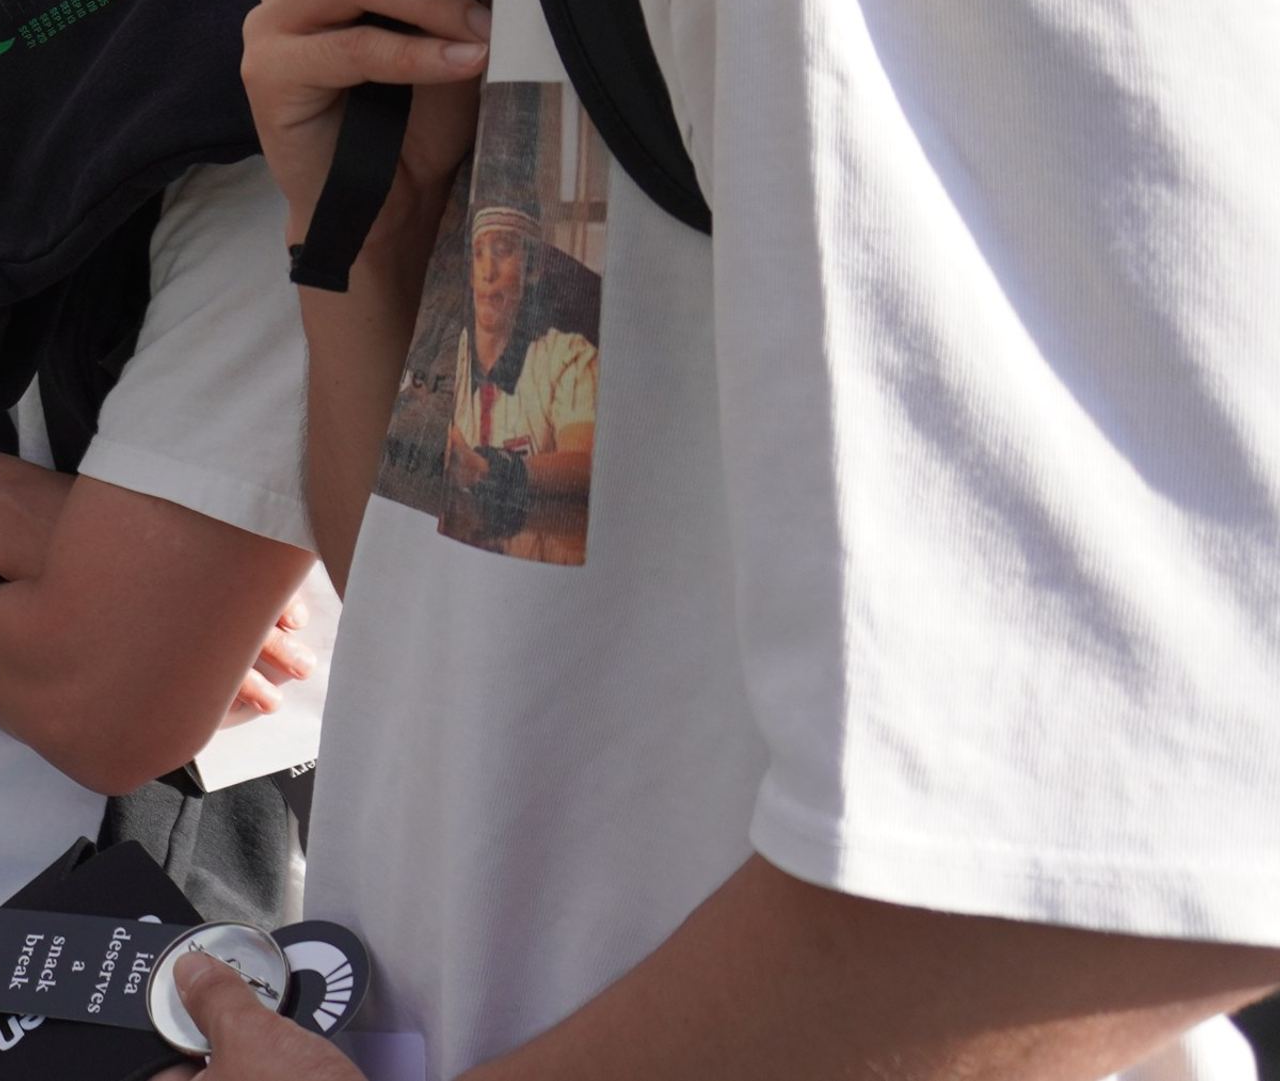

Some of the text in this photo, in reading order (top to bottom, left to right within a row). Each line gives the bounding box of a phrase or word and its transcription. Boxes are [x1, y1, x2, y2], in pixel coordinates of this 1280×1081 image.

[9, 934, 43, 990] break
[36, 936, 65, 992] snack
[72, 960, 85, 972] a
[88, 927, 131, 1013] deserves
[124, 951, 154, 994] idea
